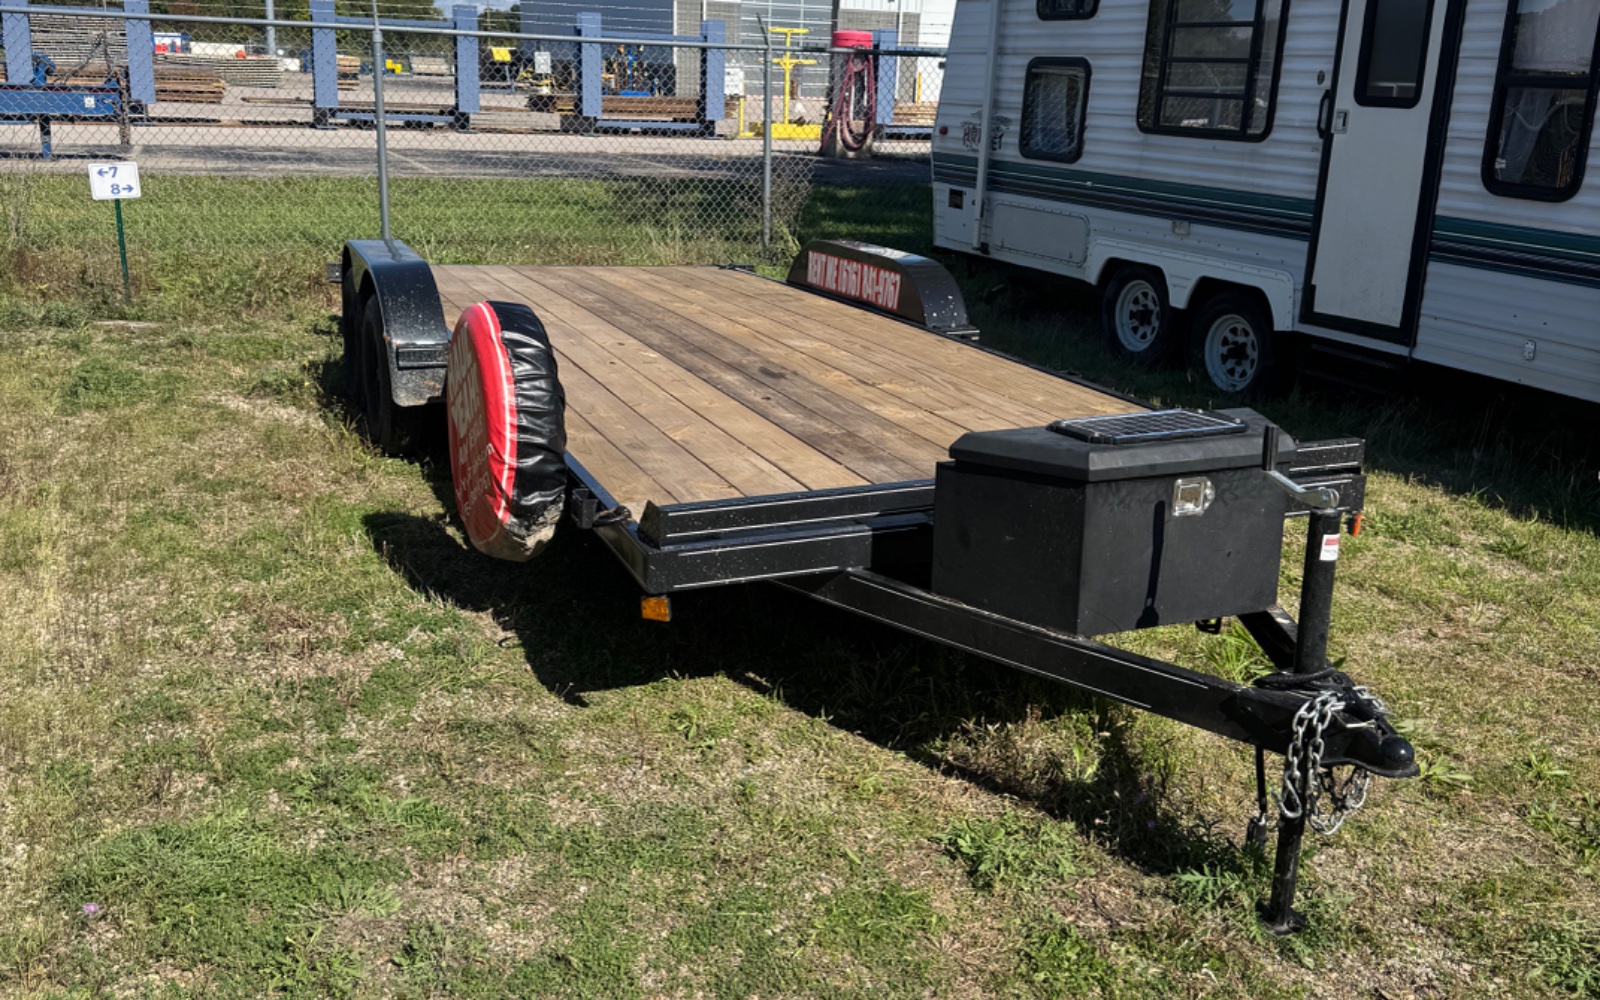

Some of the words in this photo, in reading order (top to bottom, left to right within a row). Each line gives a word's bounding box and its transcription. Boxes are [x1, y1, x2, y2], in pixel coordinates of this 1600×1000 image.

[109, 166, 118, 178] 7
[110, 183, 121, 195] 8
[807, 250, 826, 287] RENT
[825, 255, 838, 291] ME
[447, 322, 473, 403] HAUL
